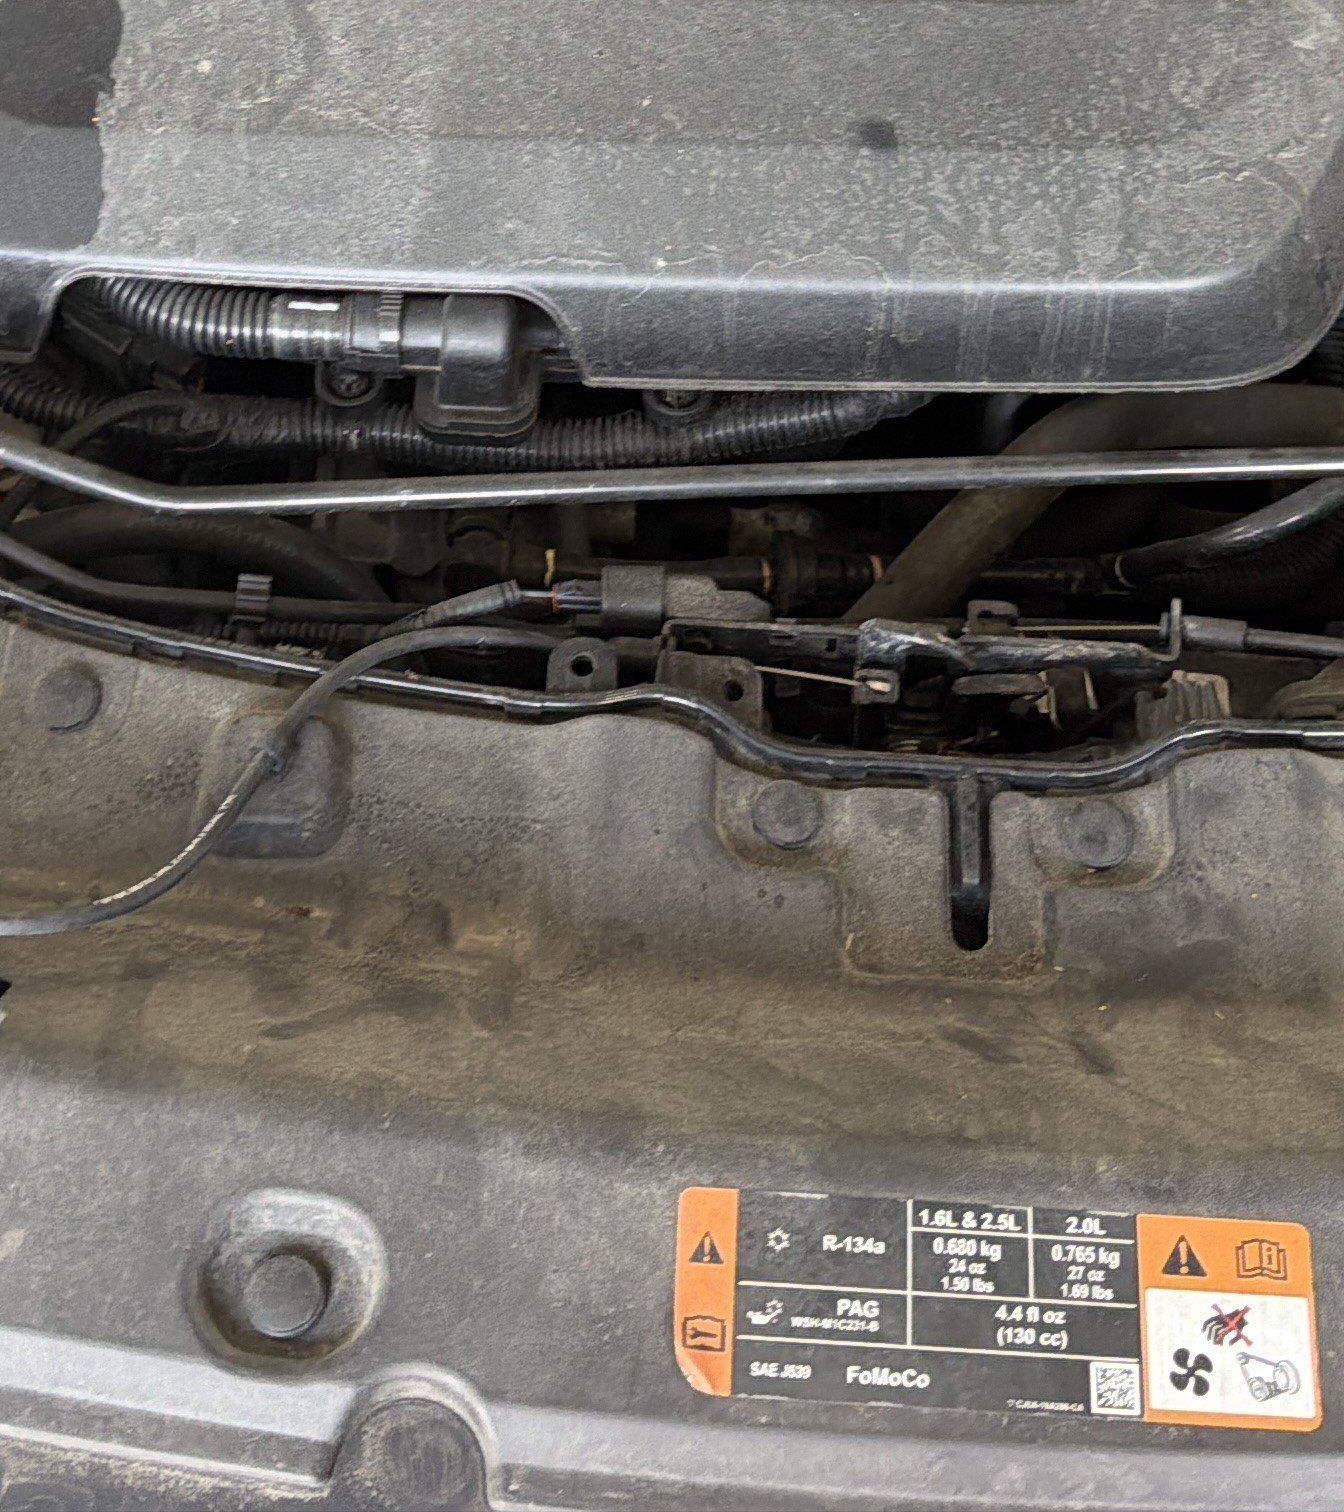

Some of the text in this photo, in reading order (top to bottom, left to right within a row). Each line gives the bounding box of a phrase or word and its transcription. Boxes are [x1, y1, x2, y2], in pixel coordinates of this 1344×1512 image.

[919, 1208, 1022, 1231] 1.6L & 2.5L
[1065, 1216, 1107, 1235] 2.0L
[822, 1234, 886, 1255] R-134a
[980, 1240, 1002, 1261] kg
[948, 1258, 987, 1274] 24 oz
[1051, 1244, 1120, 1269] 0.765 kg
[1067, 1266, 1105, 1282] 27 oz
[940, 1276, 995, 1293] 1.50 lbs
[1060, 1283, 1114, 1301] 1.69 lbs
[837, 1298, 880, 1318] PAG
[994, 1304, 1067, 1324] 4.4 fl oz
[996, 1326, 1069, 1351] (130 cc)
[749, 1361, 779, 1378] SAE
[846, 1365, 931, 1389] FoMoCo
